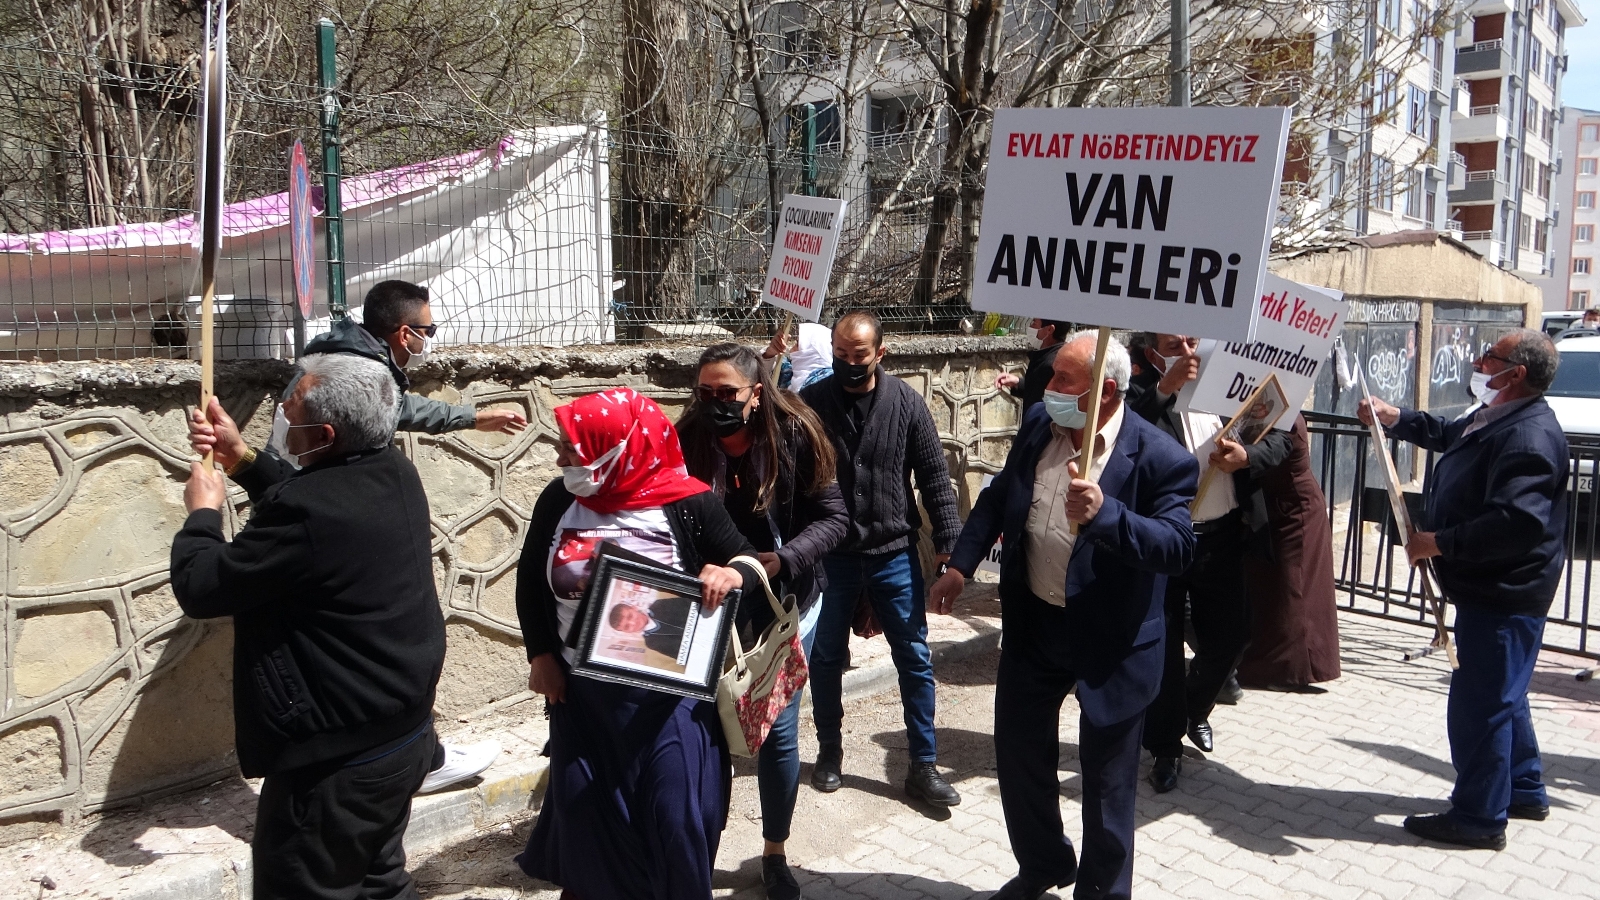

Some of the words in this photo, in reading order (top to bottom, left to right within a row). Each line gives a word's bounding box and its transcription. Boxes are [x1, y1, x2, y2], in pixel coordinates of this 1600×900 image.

[1007, 133, 1075, 158] EVLAT
[785, 206, 835, 230] ÇOCUKLARIMIZ
[1066, 172, 1174, 232] VAN
[770, 277, 816, 309] OLMAYACAK
[1260, 290, 1289, 322] rtık
[1287, 296, 1338, 339] Yeter!
